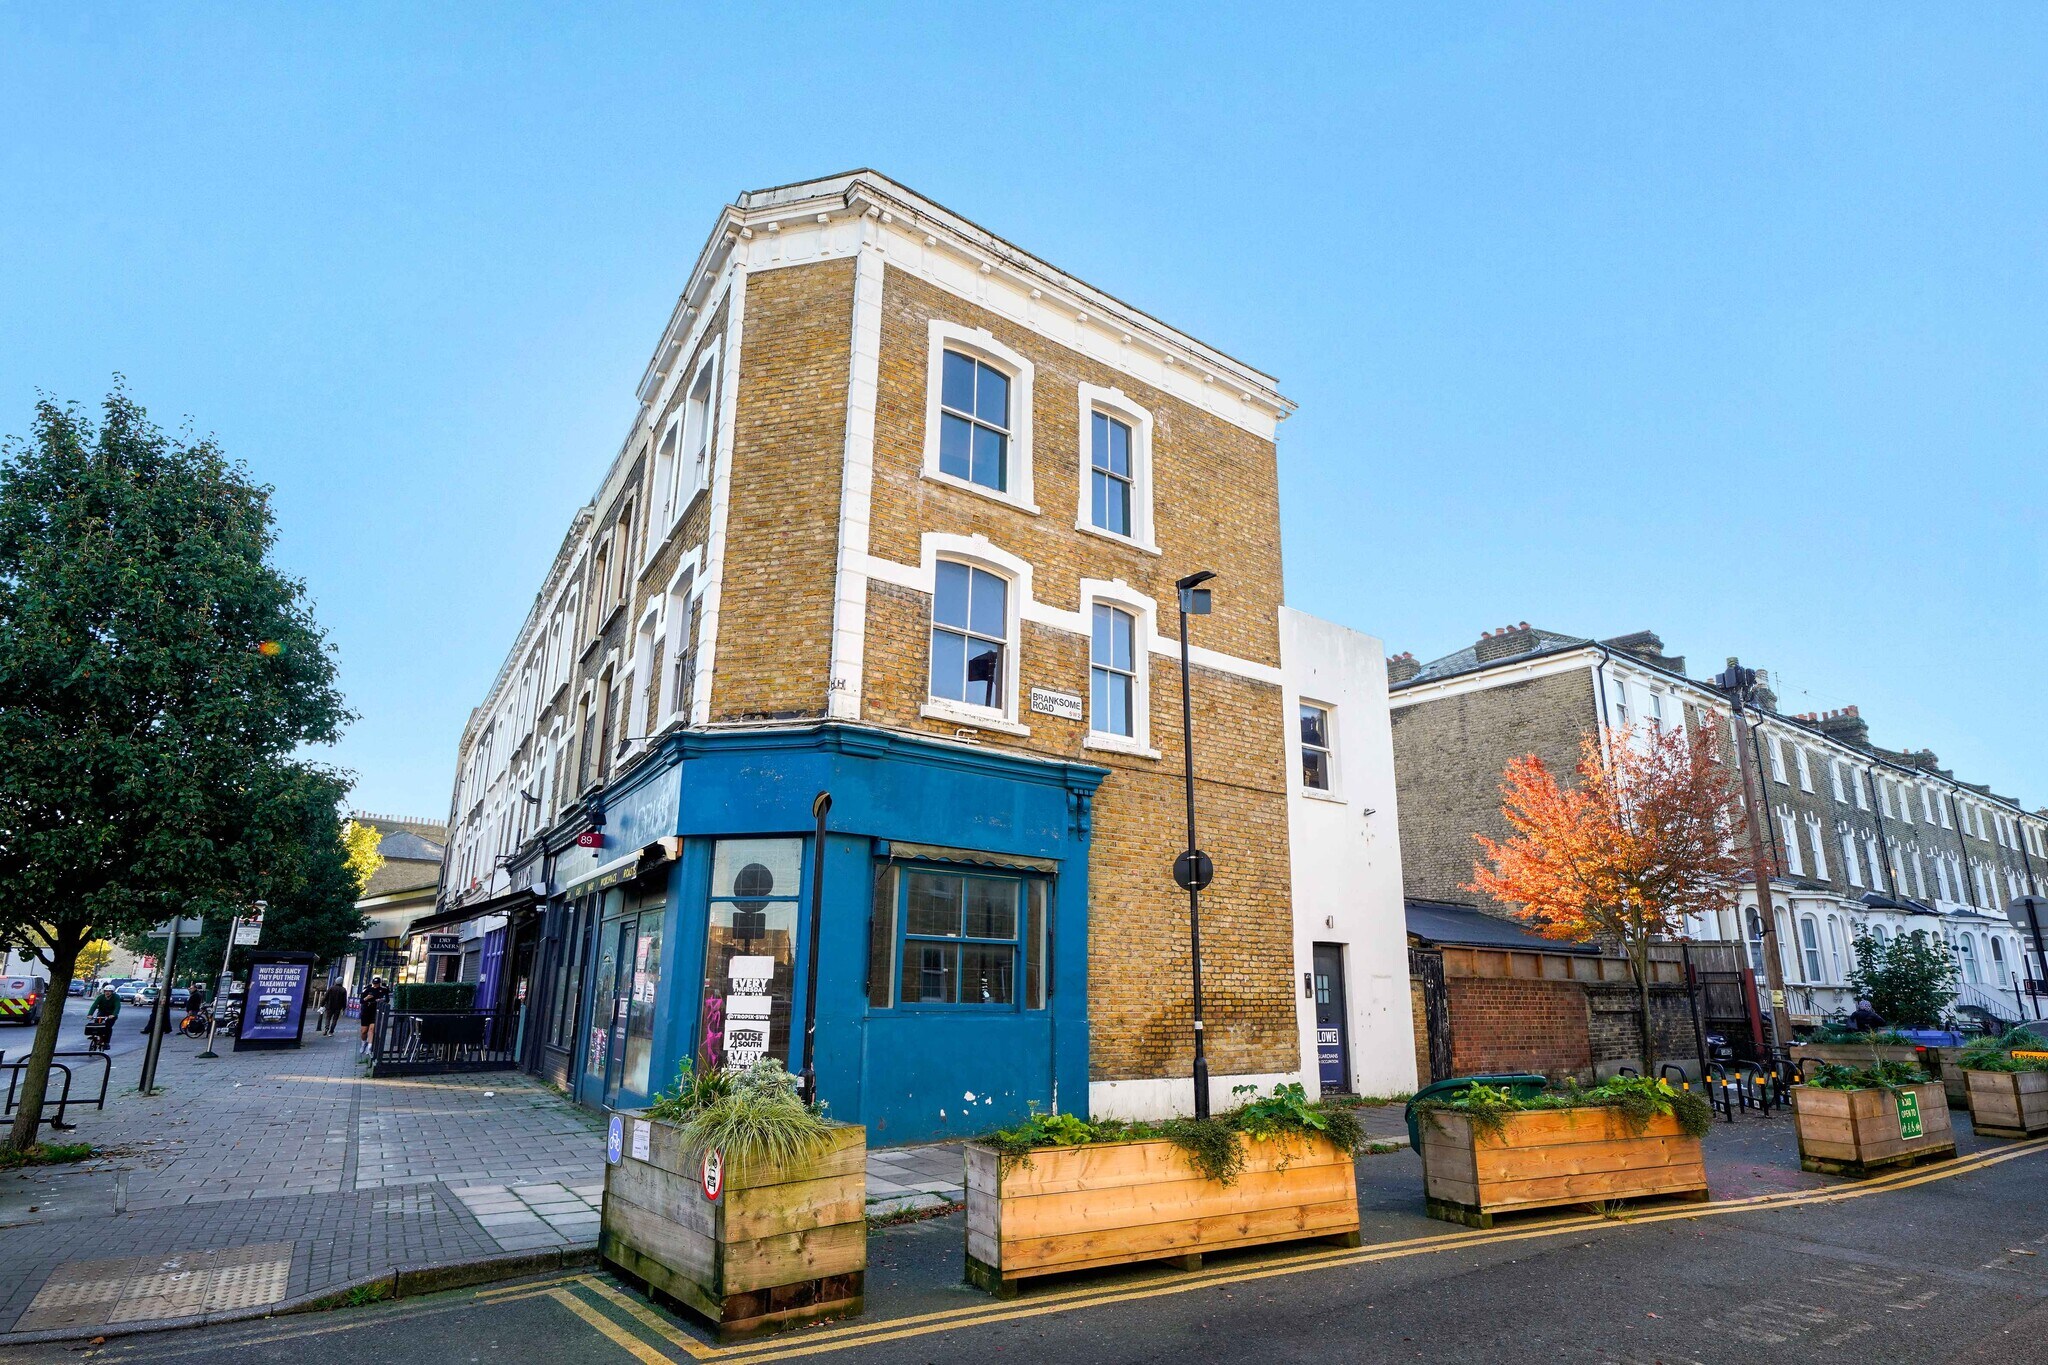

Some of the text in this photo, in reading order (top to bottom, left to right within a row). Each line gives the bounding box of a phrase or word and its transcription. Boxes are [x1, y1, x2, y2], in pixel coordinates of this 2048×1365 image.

[1032, 701, 1055, 712] ROAD
[1033, 693, 1081, 710] BRANKSOME
[580, 836, 593, 844] 89
[732, 978, 769, 988] EVERY
[729, 1032, 763, 1041] HOUSE
[1317, 1032, 1336, 1042] LOWE
[727, 1050, 764, 1061] EVERY
[1910, 1108, 1917, 1117] TO
